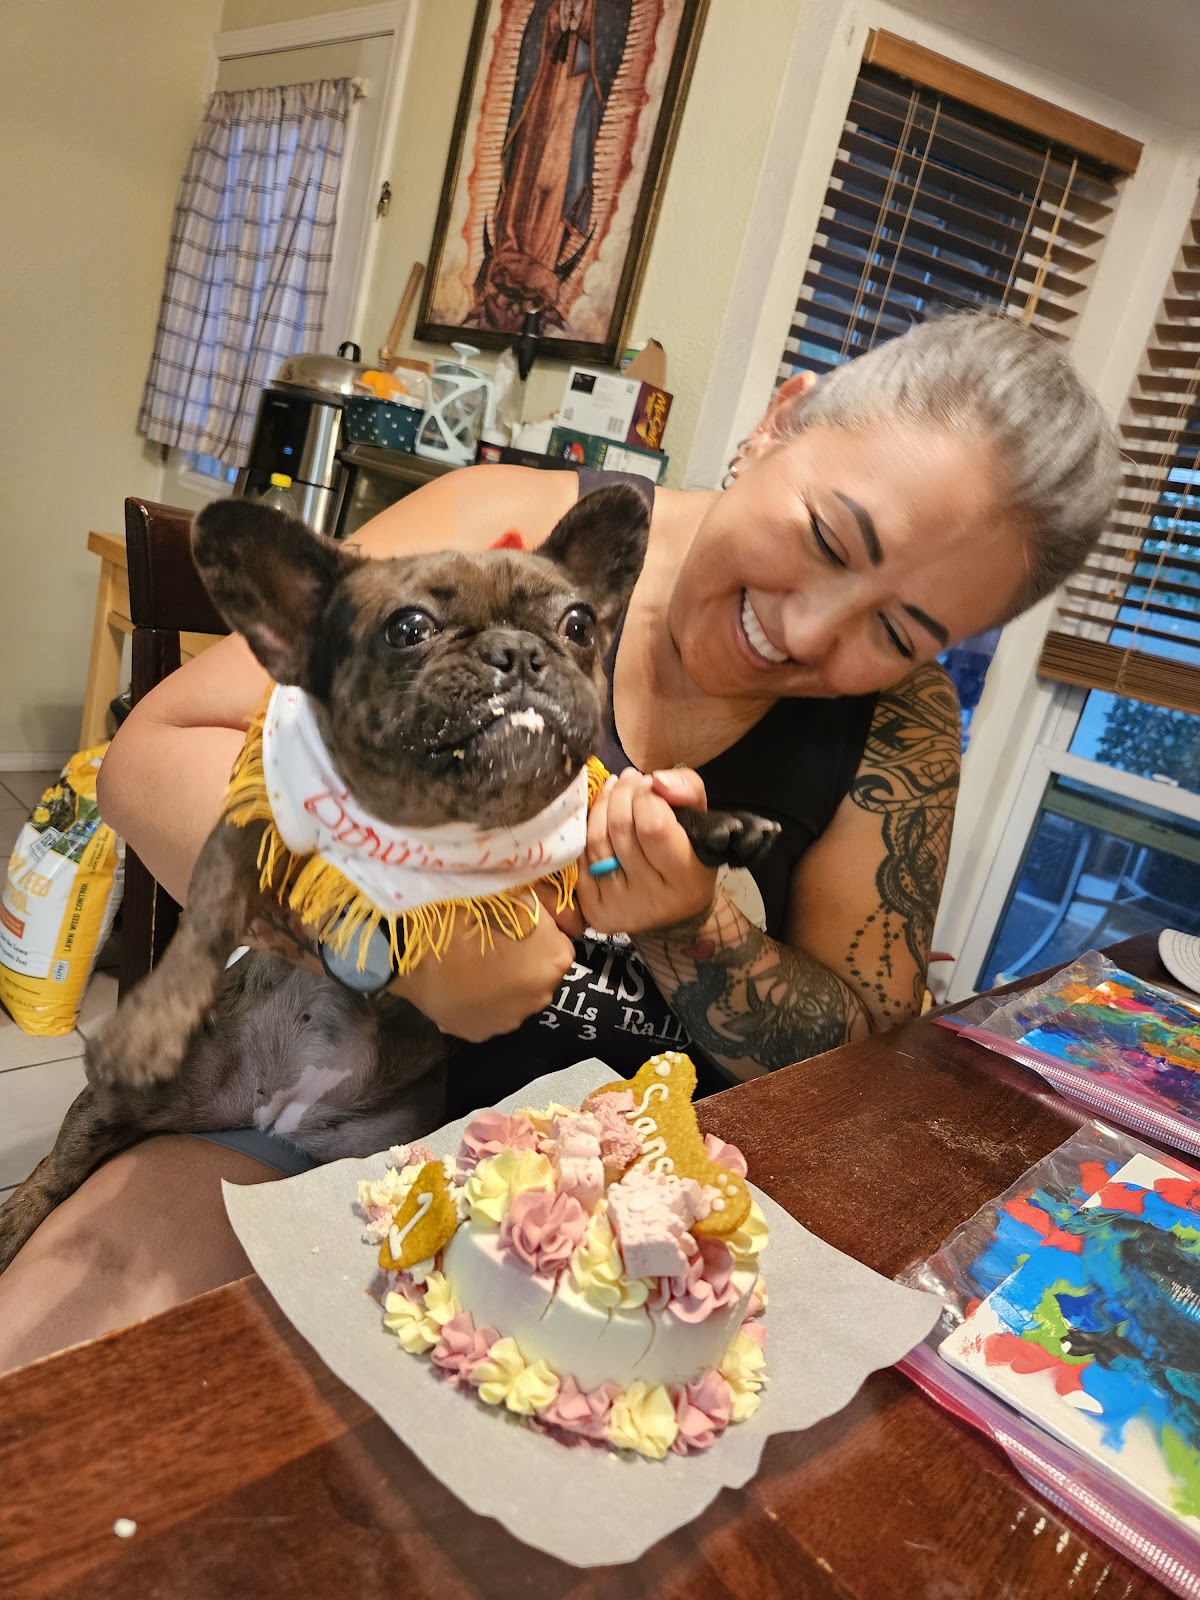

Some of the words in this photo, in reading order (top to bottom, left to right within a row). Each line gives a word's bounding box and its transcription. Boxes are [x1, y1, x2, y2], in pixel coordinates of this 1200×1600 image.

[75, 883, 89, 912] CONTROL
[69, 913, 81, 931] WEED
[64, 933, 75, 953] LAWN
[577, 1024, 598, 1041] 3
